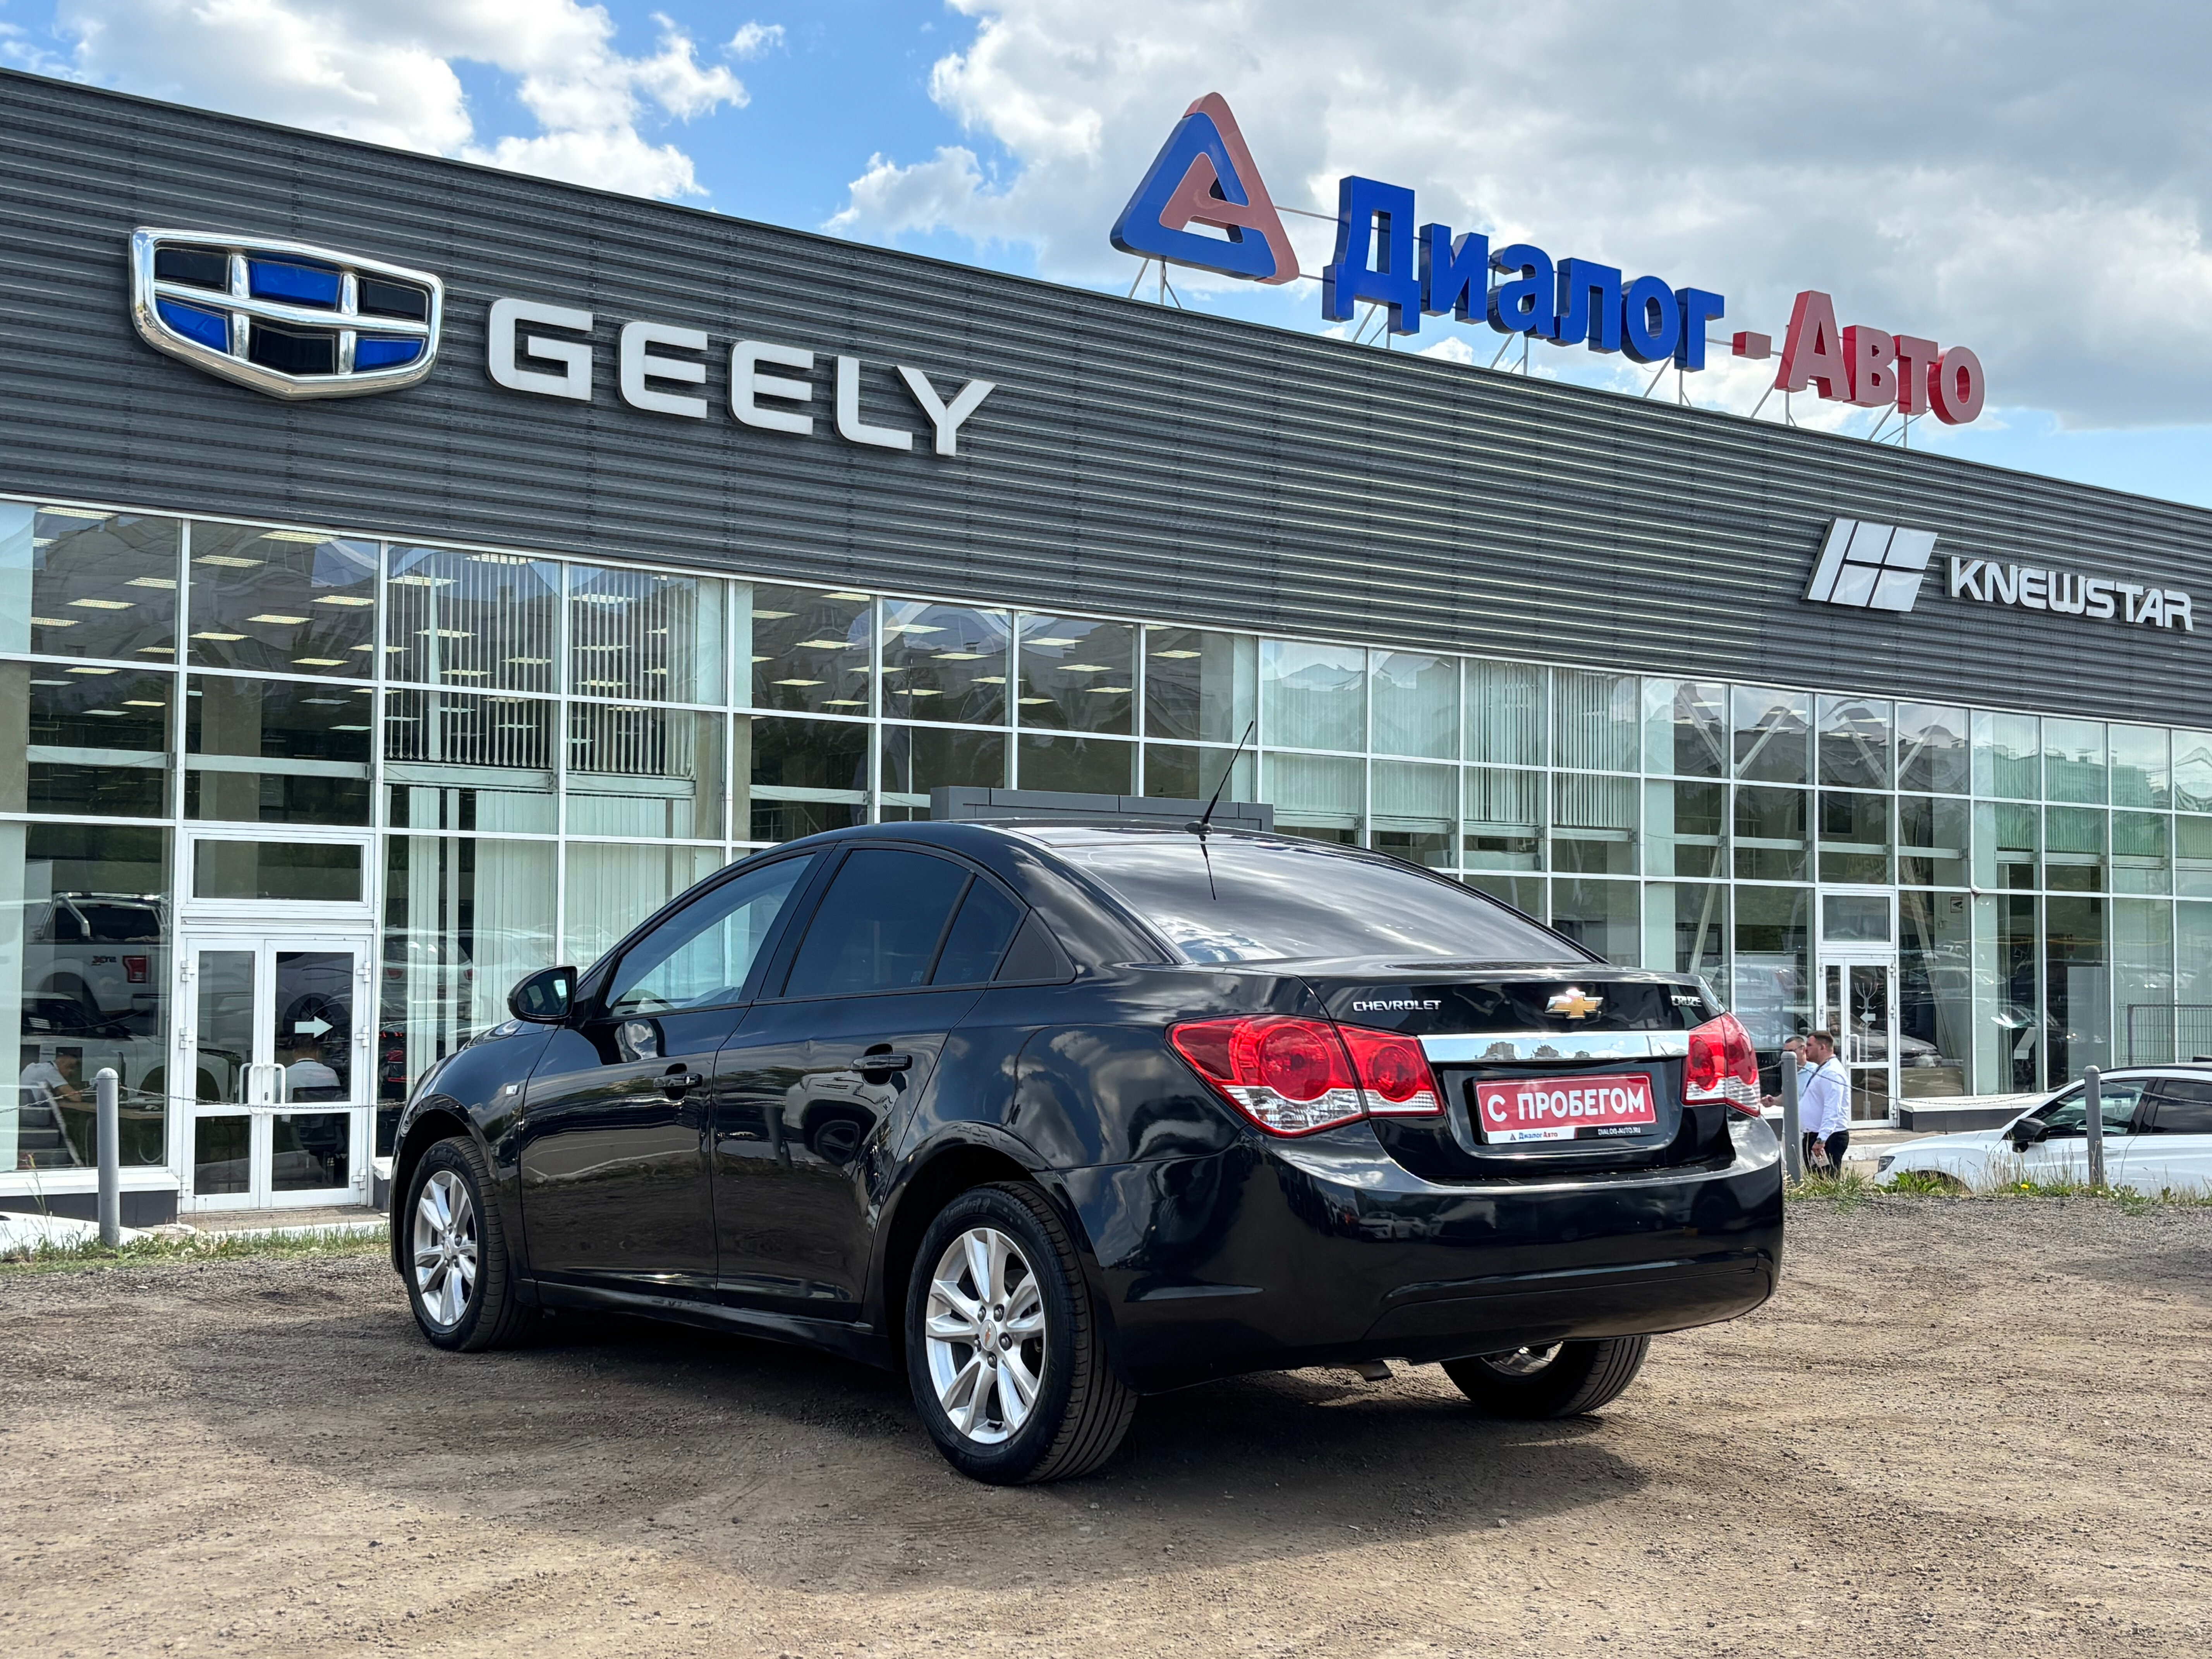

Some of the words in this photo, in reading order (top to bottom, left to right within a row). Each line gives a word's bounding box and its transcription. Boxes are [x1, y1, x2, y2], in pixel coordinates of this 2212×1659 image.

[486, 297, 997, 457] GEELY
[1945, 556, 2193, 632] KNEWSTAR
[1353, 1000, 1442, 1012] CHEVROLET
[1487, 1094, 1508, 1122] С
[1517, 1086, 1645, 1120] ПРОБЕГОМ
